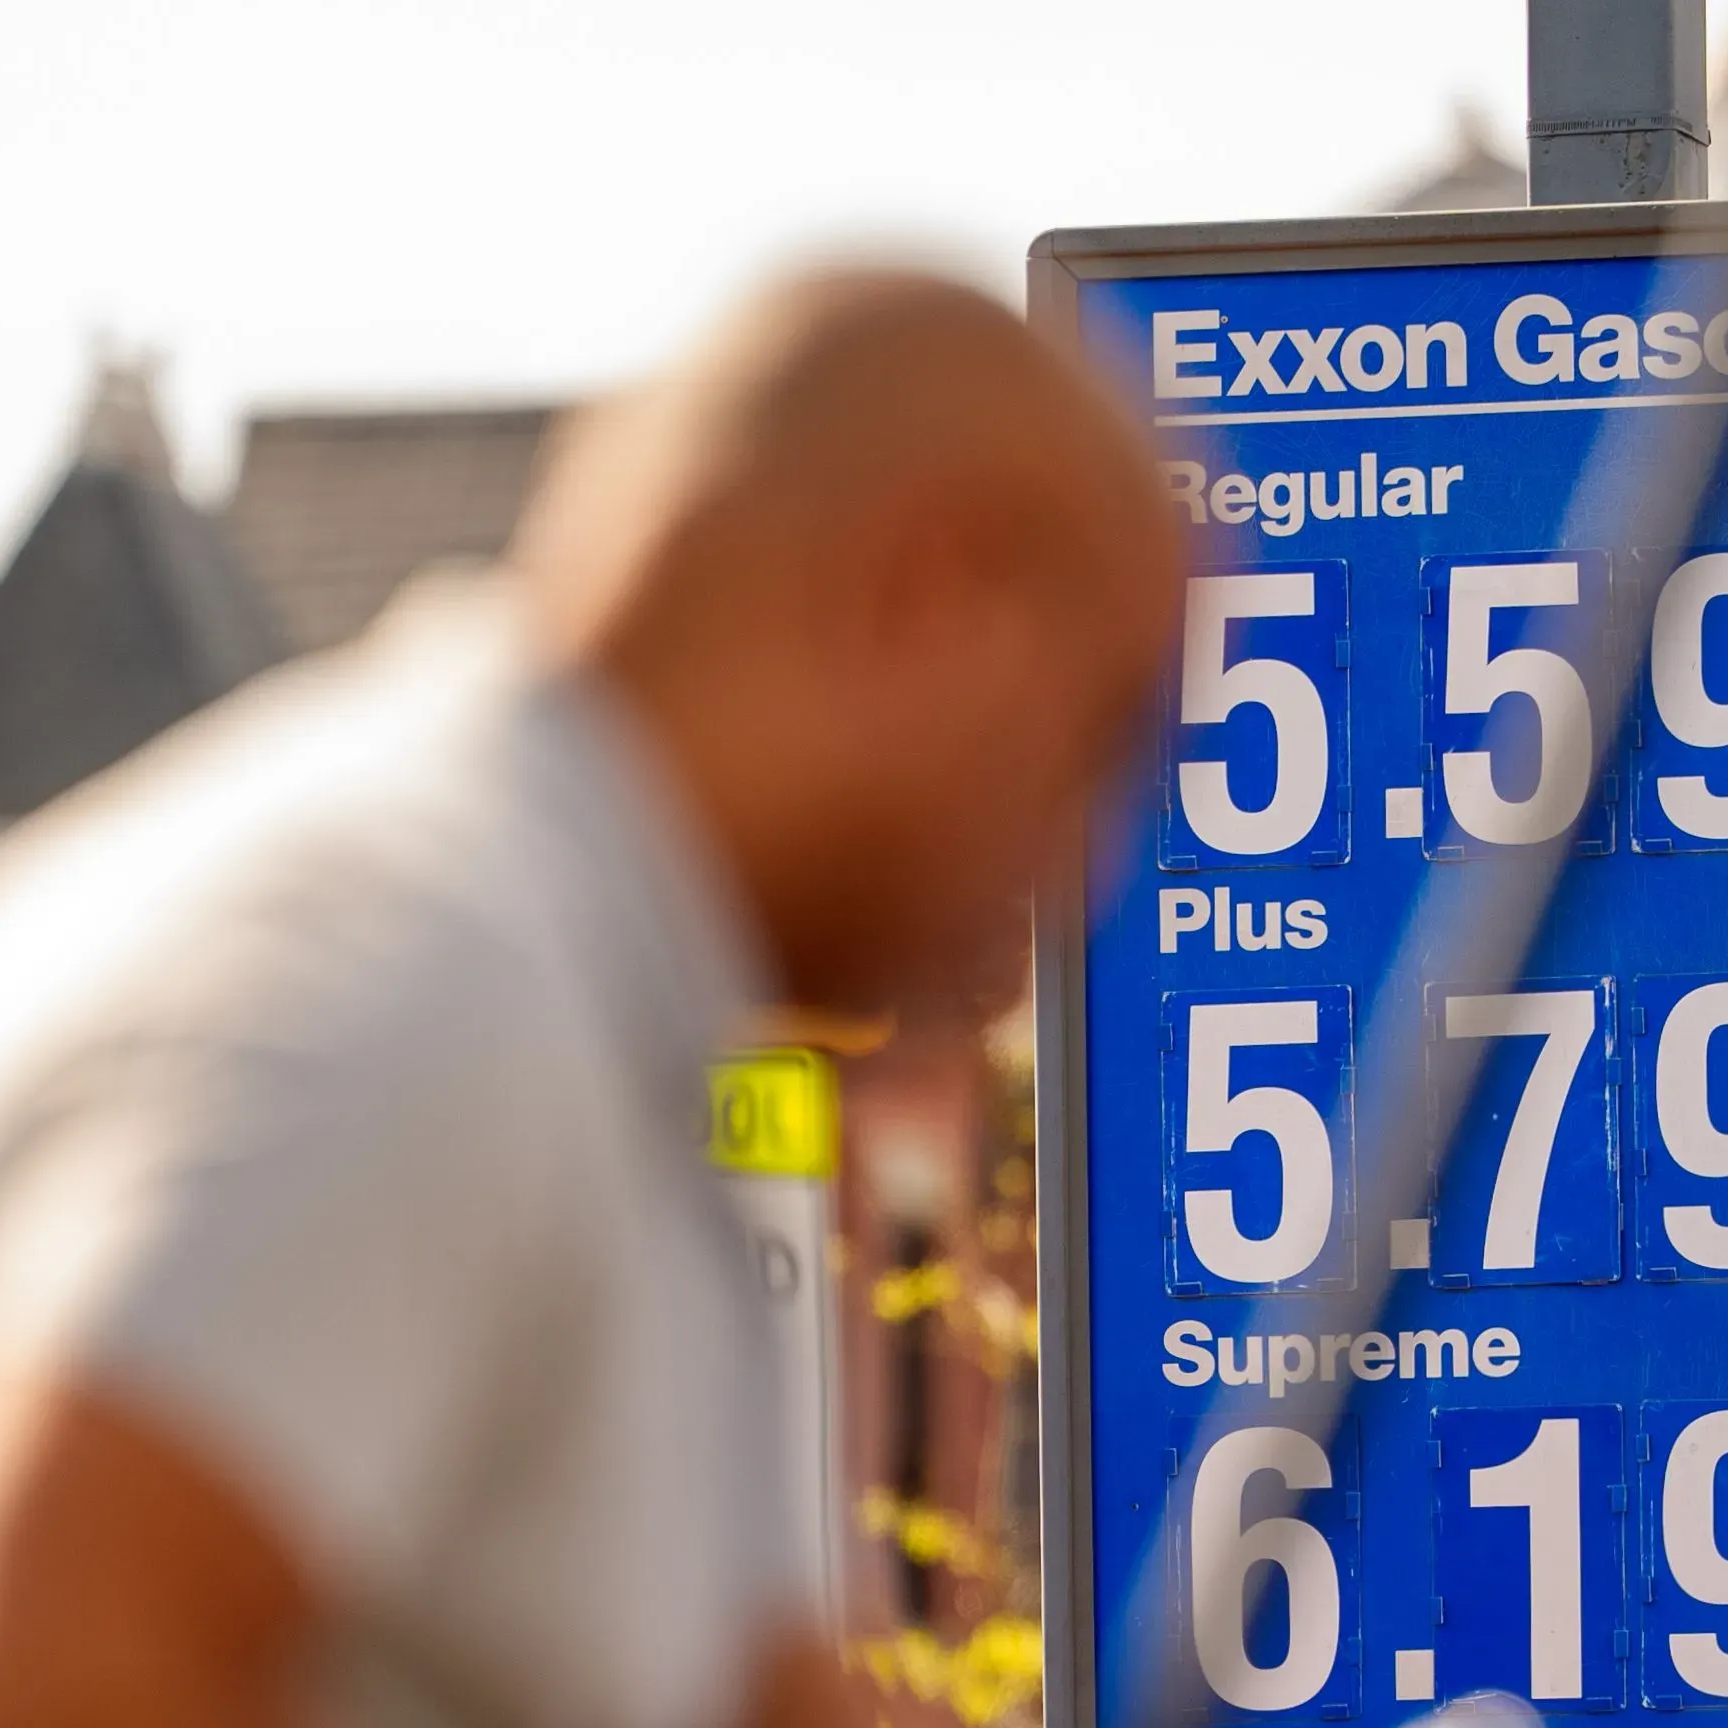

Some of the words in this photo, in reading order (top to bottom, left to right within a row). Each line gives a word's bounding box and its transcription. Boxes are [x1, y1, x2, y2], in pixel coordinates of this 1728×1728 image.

[1152, 309, 1467, 400] Exxon
[1158, 452, 1464, 537] Regular
[1158, 886, 1329, 954] Plus
[1161, 1320, 1521, 1398] Supreme
